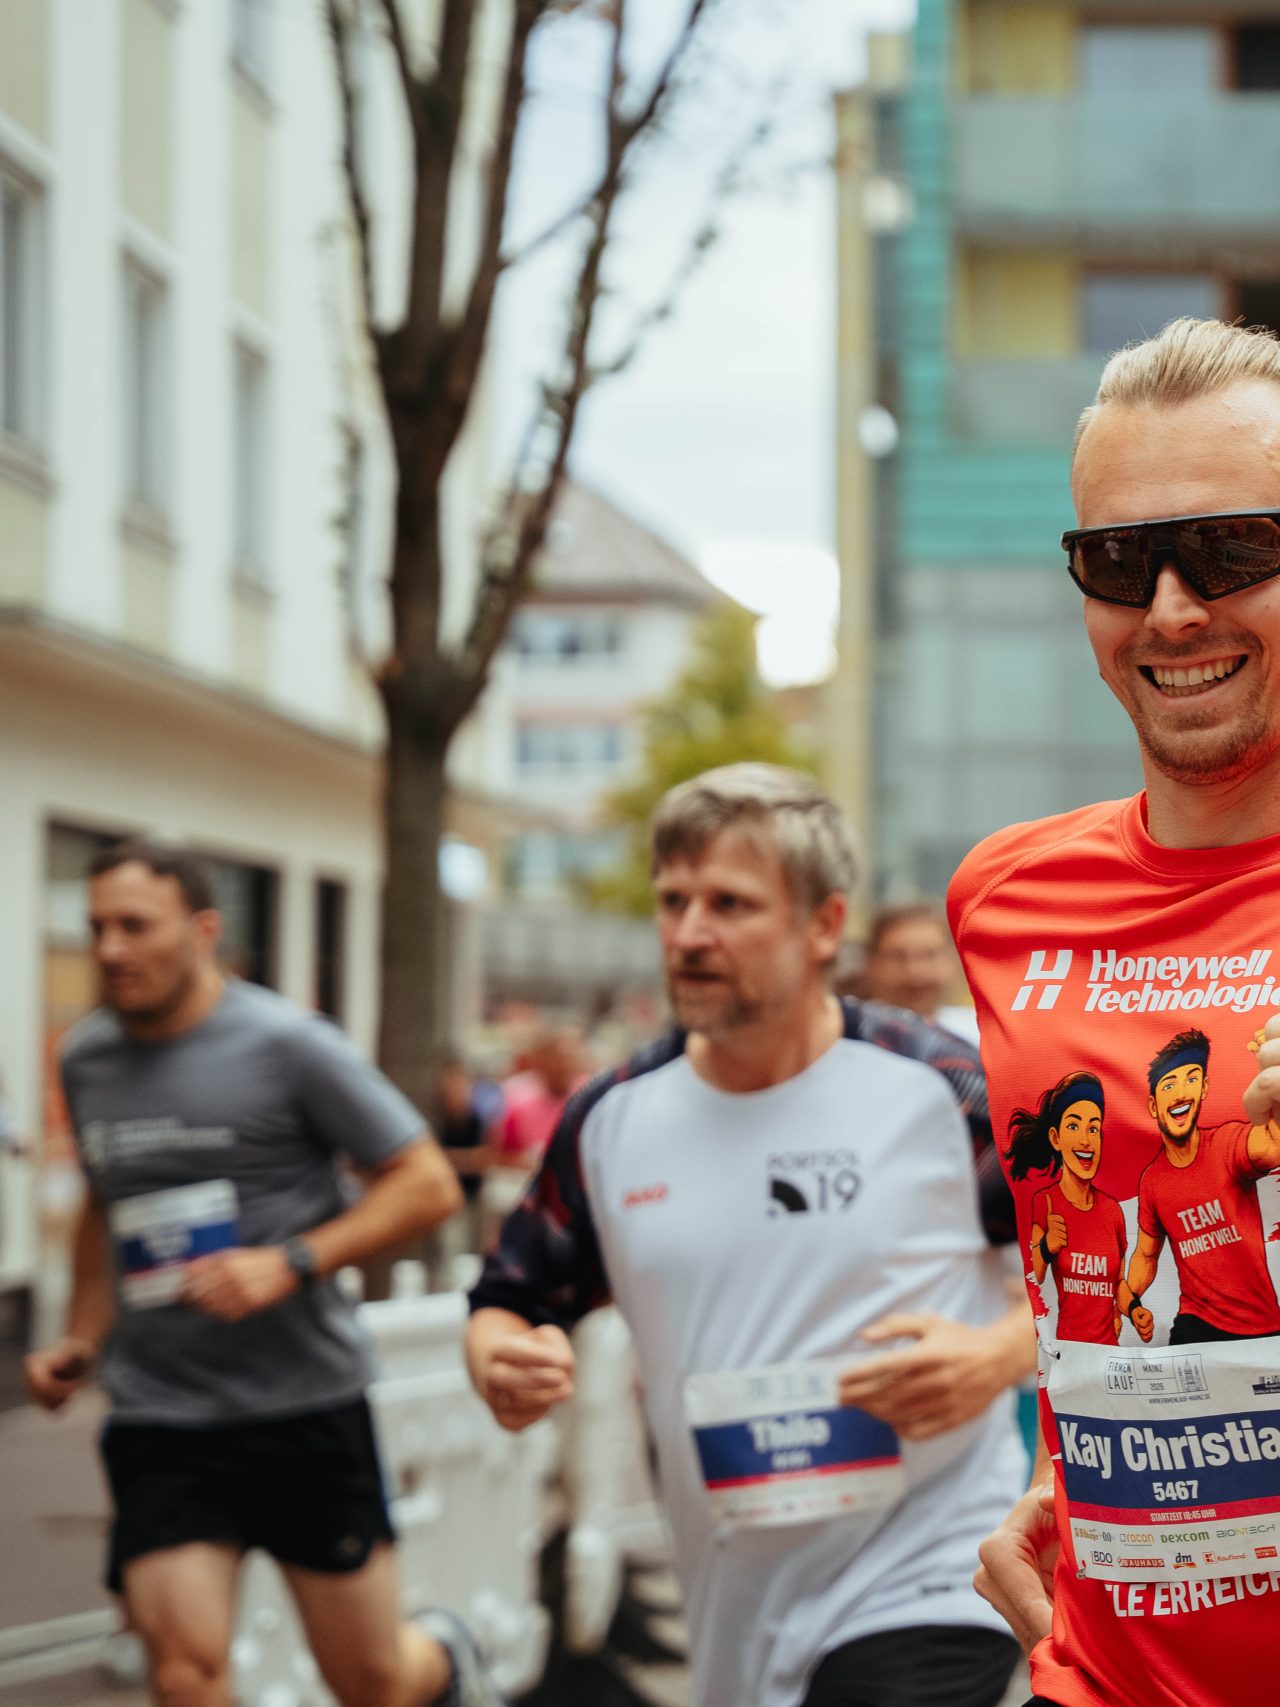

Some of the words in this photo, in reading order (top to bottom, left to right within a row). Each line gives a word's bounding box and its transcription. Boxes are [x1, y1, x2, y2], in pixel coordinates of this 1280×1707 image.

[1089, 949, 1272, 988] Honeywell
[815, 1170, 861, 1212] 19
[1176, 1199, 1225, 1234] TEAM
[1178, 1224, 1242, 1259] HONEYWELL
[1070, 1252, 1107, 1277] TEAM
[1063, 1276, 1114, 1298] HONEYWELL
[1108, 1361, 1132, 1373] FIRMEN
[1142, 1364, 1163, 1374] MAINZ
[1107, 1375, 1134, 1390] LAUF
[1059, 1421, 1112, 1479] Kay
[1152, 1480, 1199, 1502] 5467
[1150, 1512, 1183, 1522] STARTZEIT
[1201, 1509, 1217, 1518] UHR
[1093, 1550, 1113, 1563] BDO
[1123, 1559, 1164, 1567] BAUHAUS
[1175, 1552, 1192, 1563] dm
[1217, 1552, 1246, 1562] Kaufland
